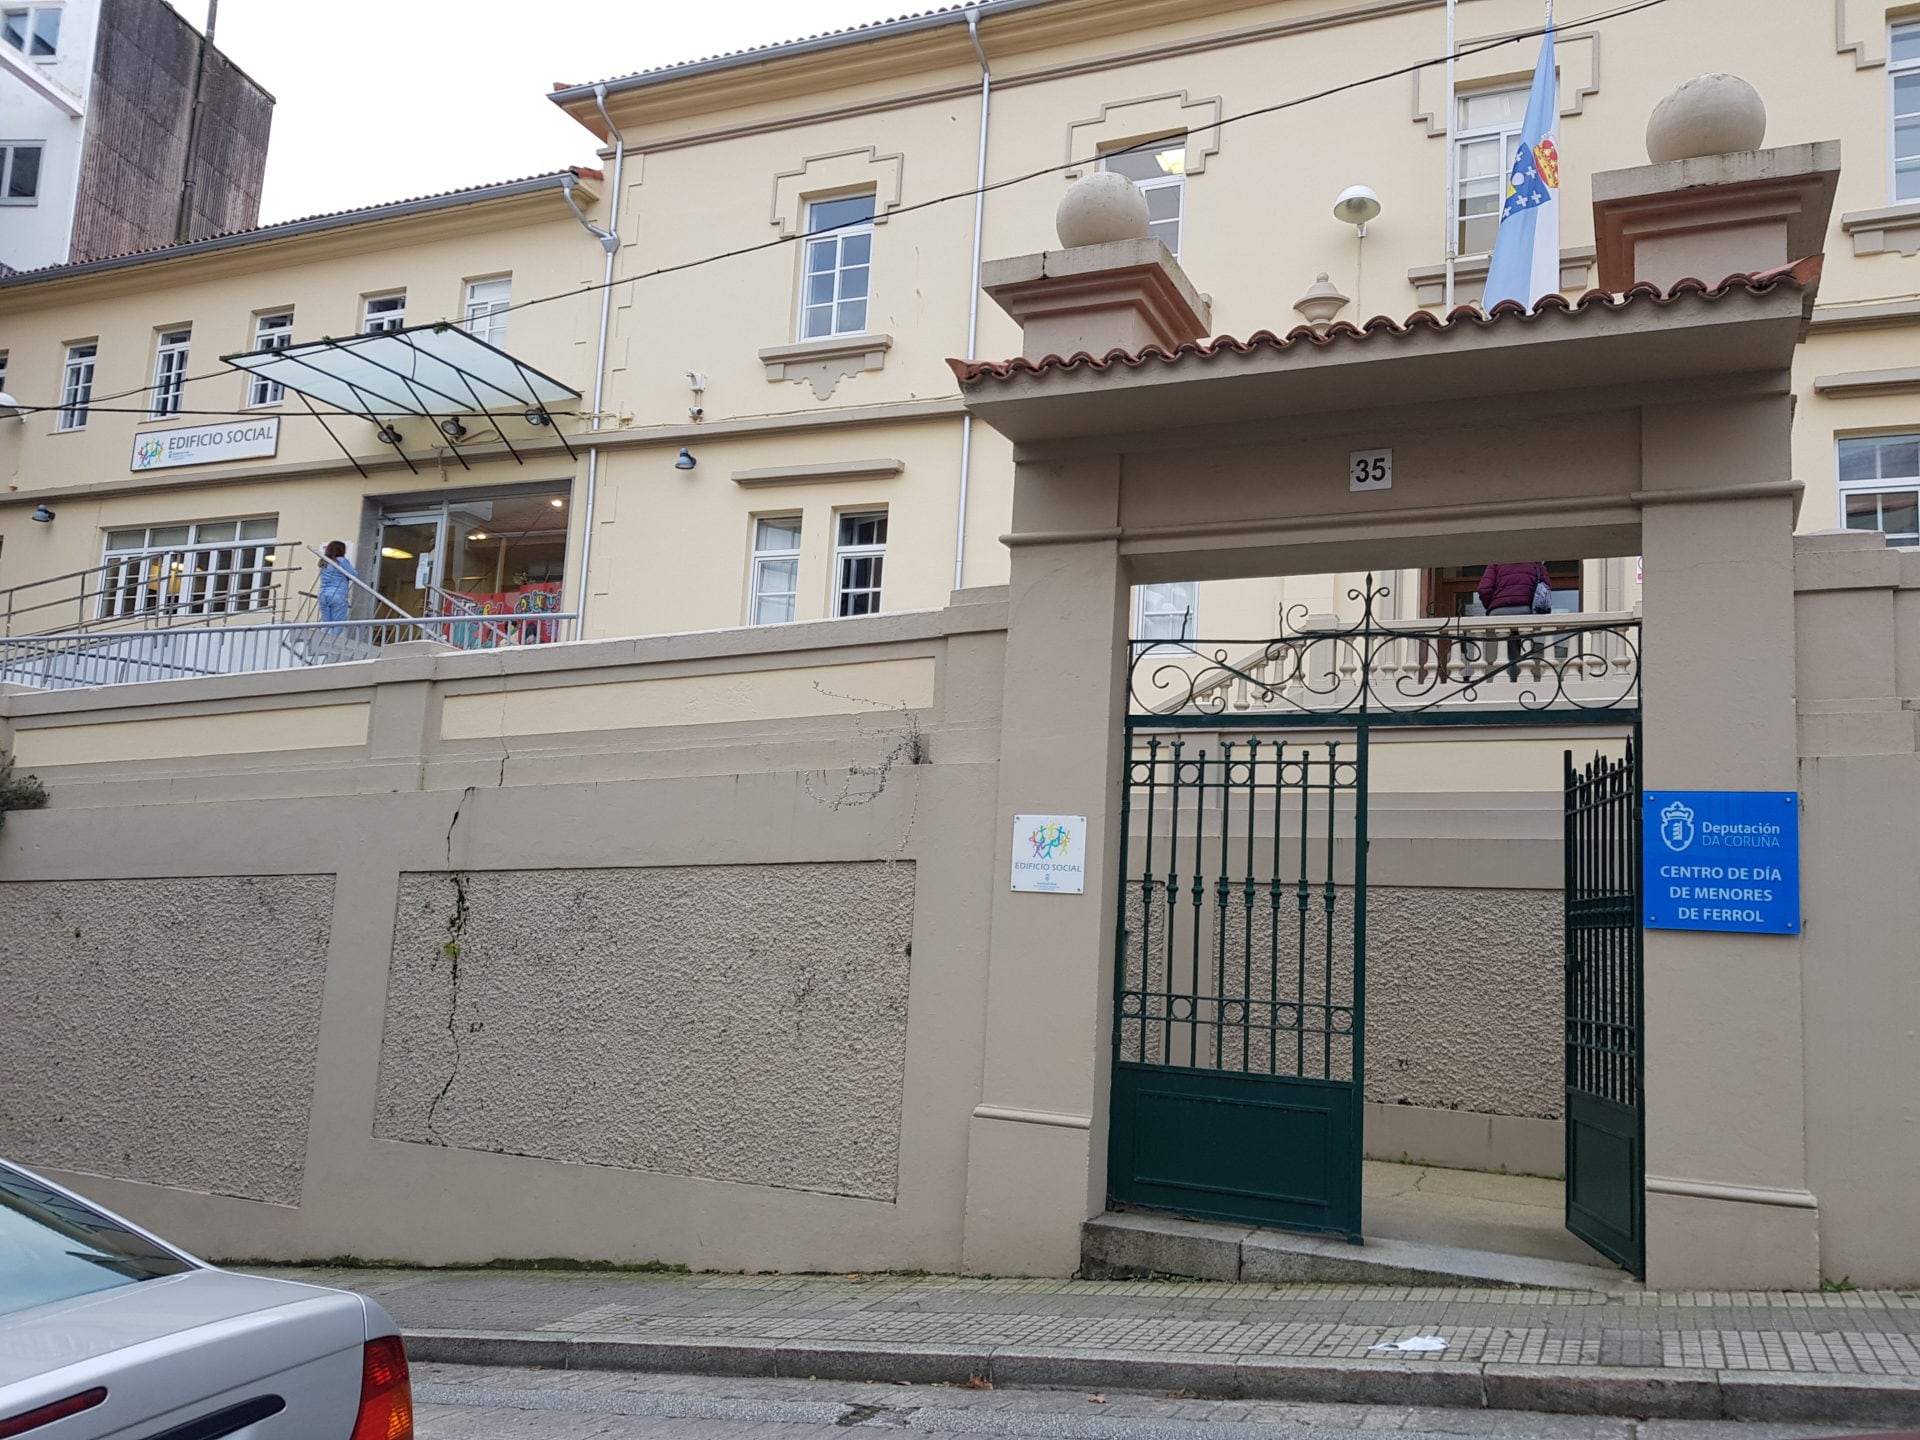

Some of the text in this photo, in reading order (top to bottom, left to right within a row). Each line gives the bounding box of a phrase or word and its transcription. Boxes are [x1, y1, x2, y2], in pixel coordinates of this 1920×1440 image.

[168, 426, 273, 450] EDIFICIO SOCIAL
[1355, 457, 1386, 483] 35
[1702, 821, 1780, 836] Deputación
[1702, 833, 1780, 848] DA CORUÑA
[1014, 862, 1082, 872] EDIFICIO SOCIAL
[1660, 865, 1782, 881] CENTRO DE DÍA
[1669, 886, 1773, 902] DE MENORES
[1678, 907, 1765, 923] DE FERROL
